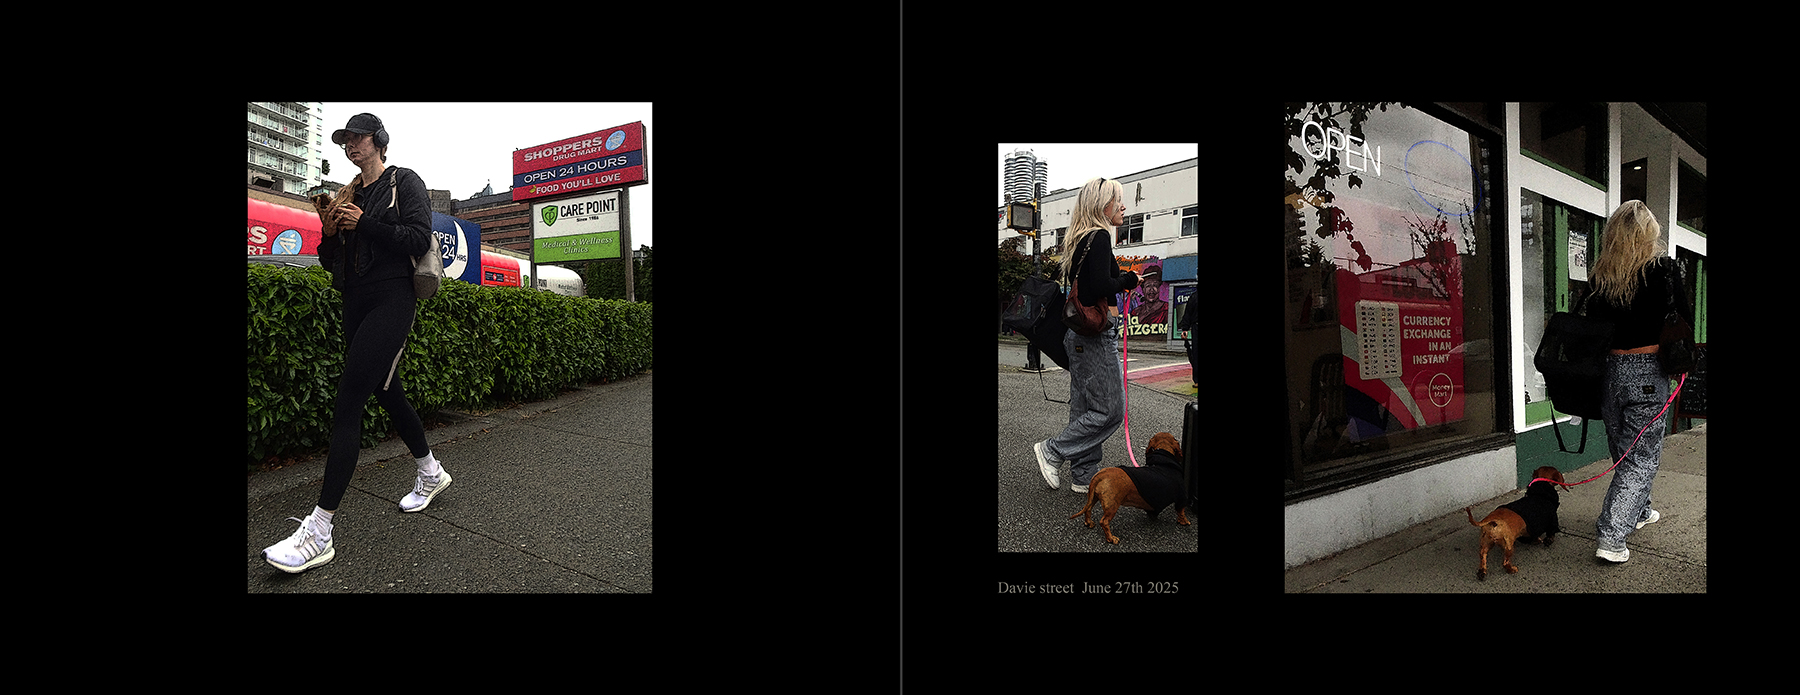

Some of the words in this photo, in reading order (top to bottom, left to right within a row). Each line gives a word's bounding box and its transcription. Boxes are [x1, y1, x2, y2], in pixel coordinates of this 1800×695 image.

[524, 136, 602, 162] SHOPPERS
[553, 152, 576, 162] DRUG
[578, 146, 602, 158] MART
[1302, 120, 1381, 176] OPEN
[524, 170, 556, 183] OPEN
[560, 166, 574, 177] 24
[578, 156, 627, 173] HOURS
[536, 184, 559, 194] FOOD
[562, 180, 593, 190] YOU'LL
[596, 173, 621, 185] LOVE
[560, 204, 584, 218] CARE
[586, 198, 616, 213] POINT
[248, 226, 268, 244] S
[542, 240, 569, 248] Medical
[579, 236, 613, 245] Wellness
[442, 244, 455, 259] 24
[457, 254, 467, 262] HRS
[1403, 316, 1451, 326] CURRENCY
[1403, 329, 1451, 339] EXCHANGE
[1428, 342, 1437, 351] IN
[1440, 341, 1451, 351] AN
[1413, 354, 1450, 365] INSTANT
